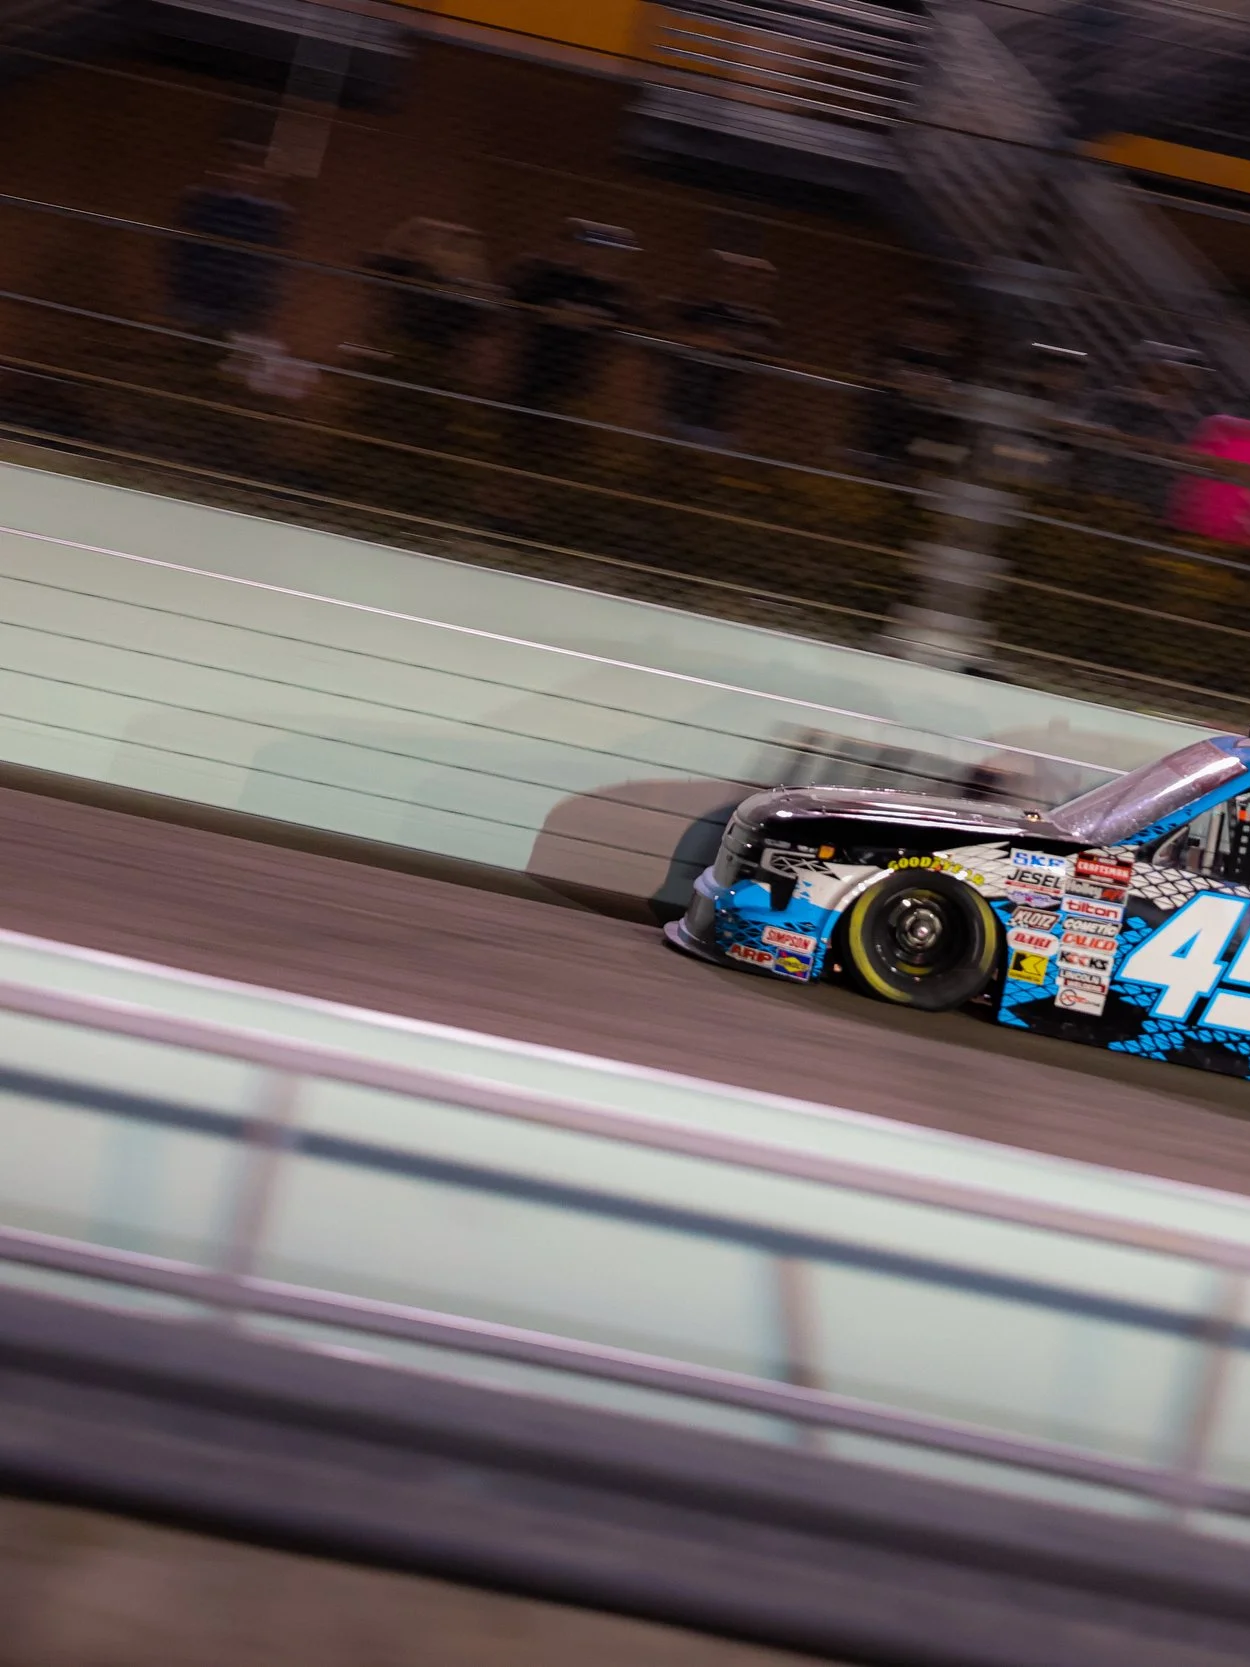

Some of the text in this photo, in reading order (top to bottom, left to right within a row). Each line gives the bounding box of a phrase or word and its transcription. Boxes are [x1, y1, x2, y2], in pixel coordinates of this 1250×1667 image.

[1013, 852, 1064, 867] SKF
[1007, 868, 1061, 888] JESEL
[1066, 899, 1118, 919] tilton
[1013, 910, 1055, 928] KLOTZ
[731, 944, 773, 962] ARP
